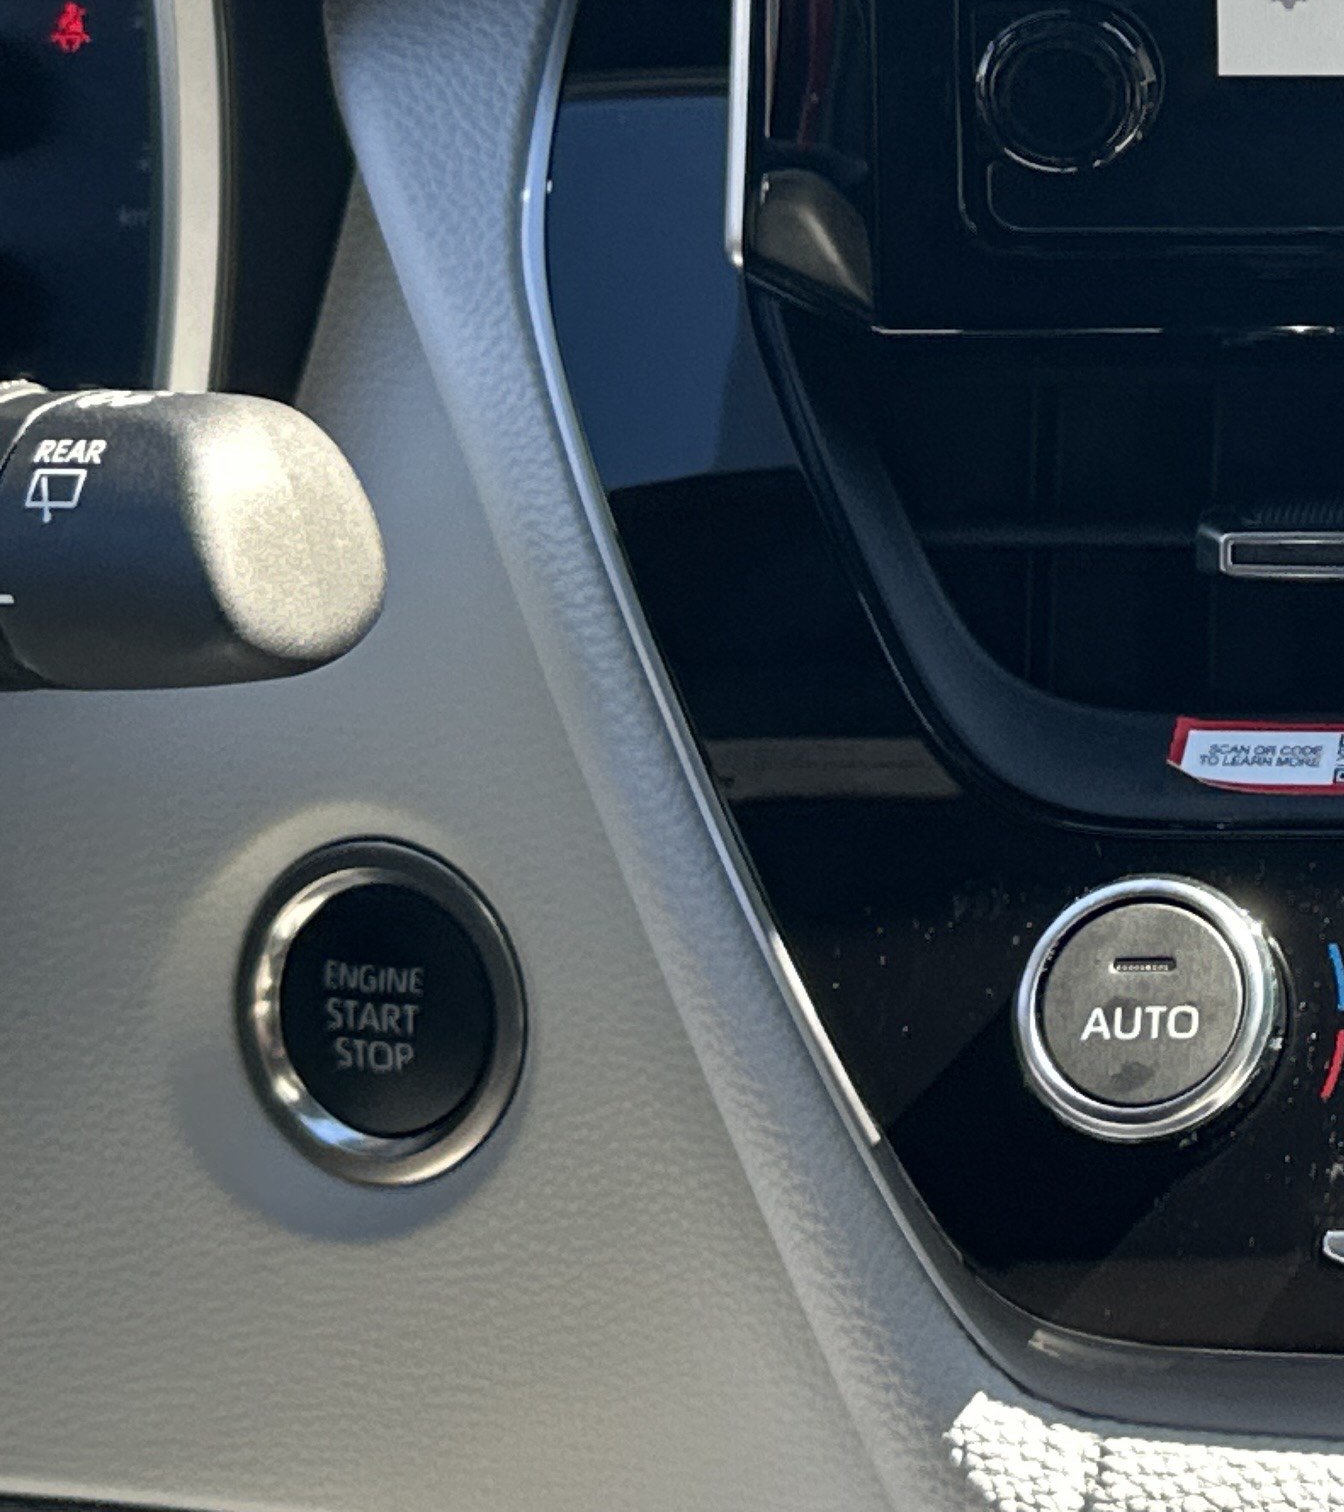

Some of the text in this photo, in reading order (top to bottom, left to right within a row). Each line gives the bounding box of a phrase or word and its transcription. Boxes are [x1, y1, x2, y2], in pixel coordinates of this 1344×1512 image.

[33, 439, 107, 464] REAR
[1200, 753, 1321, 768] TO LEARN MORE
[1208, 744, 1251, 756] SCAN
[1280, 745, 1324, 756] CODE
[324, 959, 425, 995] ENGINE
[326, 997, 419, 1035] START
[1081, 1006, 1200, 1041] AUTO
[334, 1036, 414, 1072] STOP
